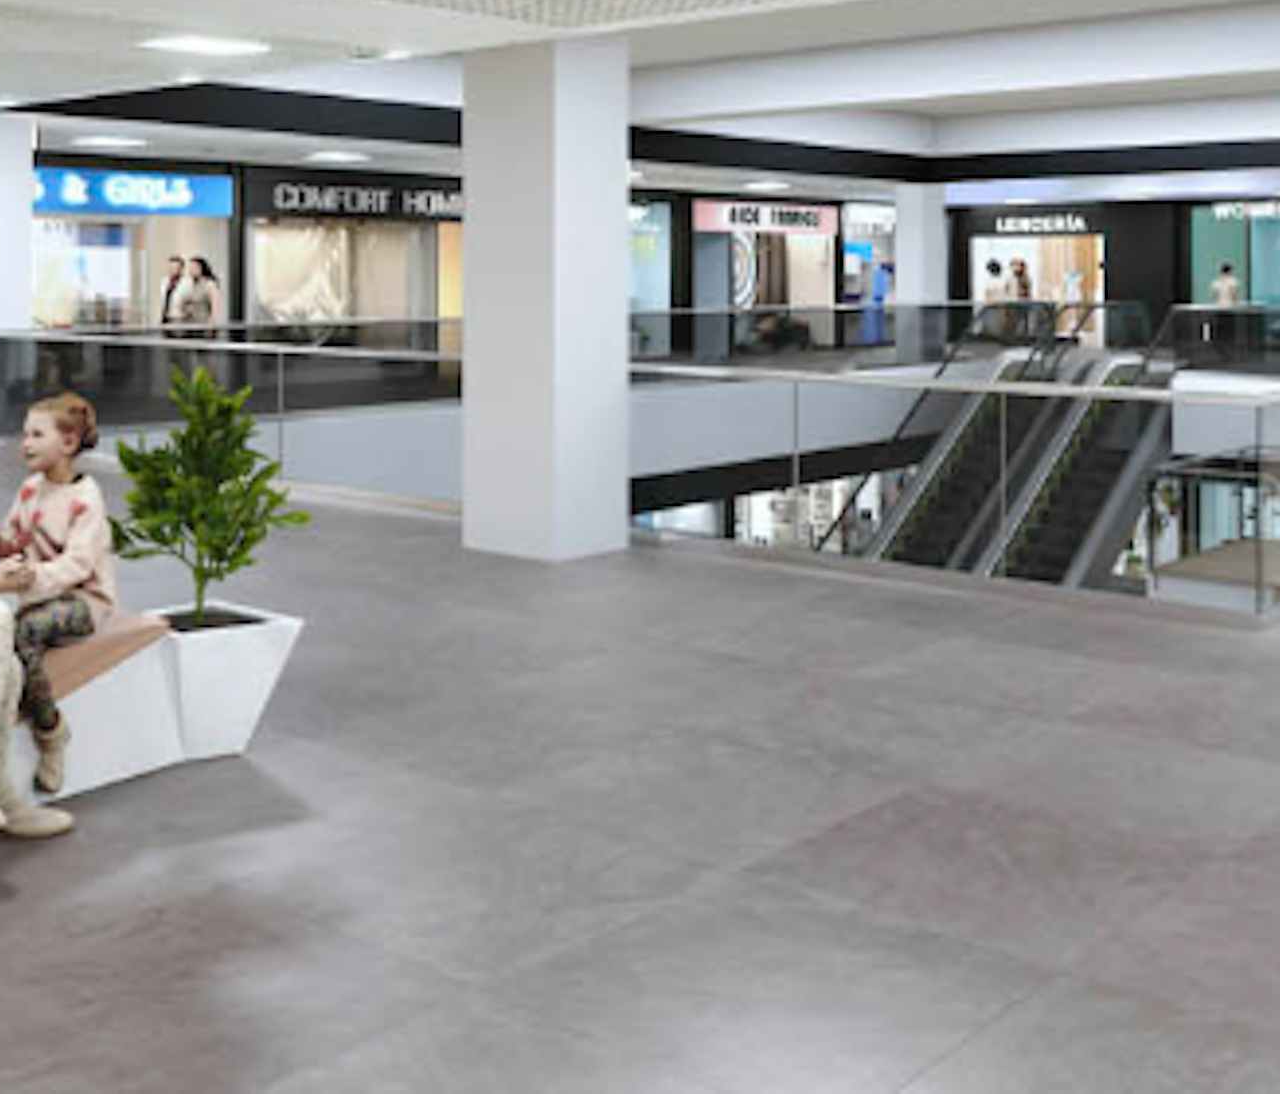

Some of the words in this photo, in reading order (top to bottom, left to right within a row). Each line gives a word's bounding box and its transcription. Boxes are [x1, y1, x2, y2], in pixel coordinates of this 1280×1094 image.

[61, 173, 89, 204] &
[103, 174, 193, 209] GIRLS
[274, 183, 391, 213] COMFORT
[995, 213, 1087, 234] LENCERÍA
